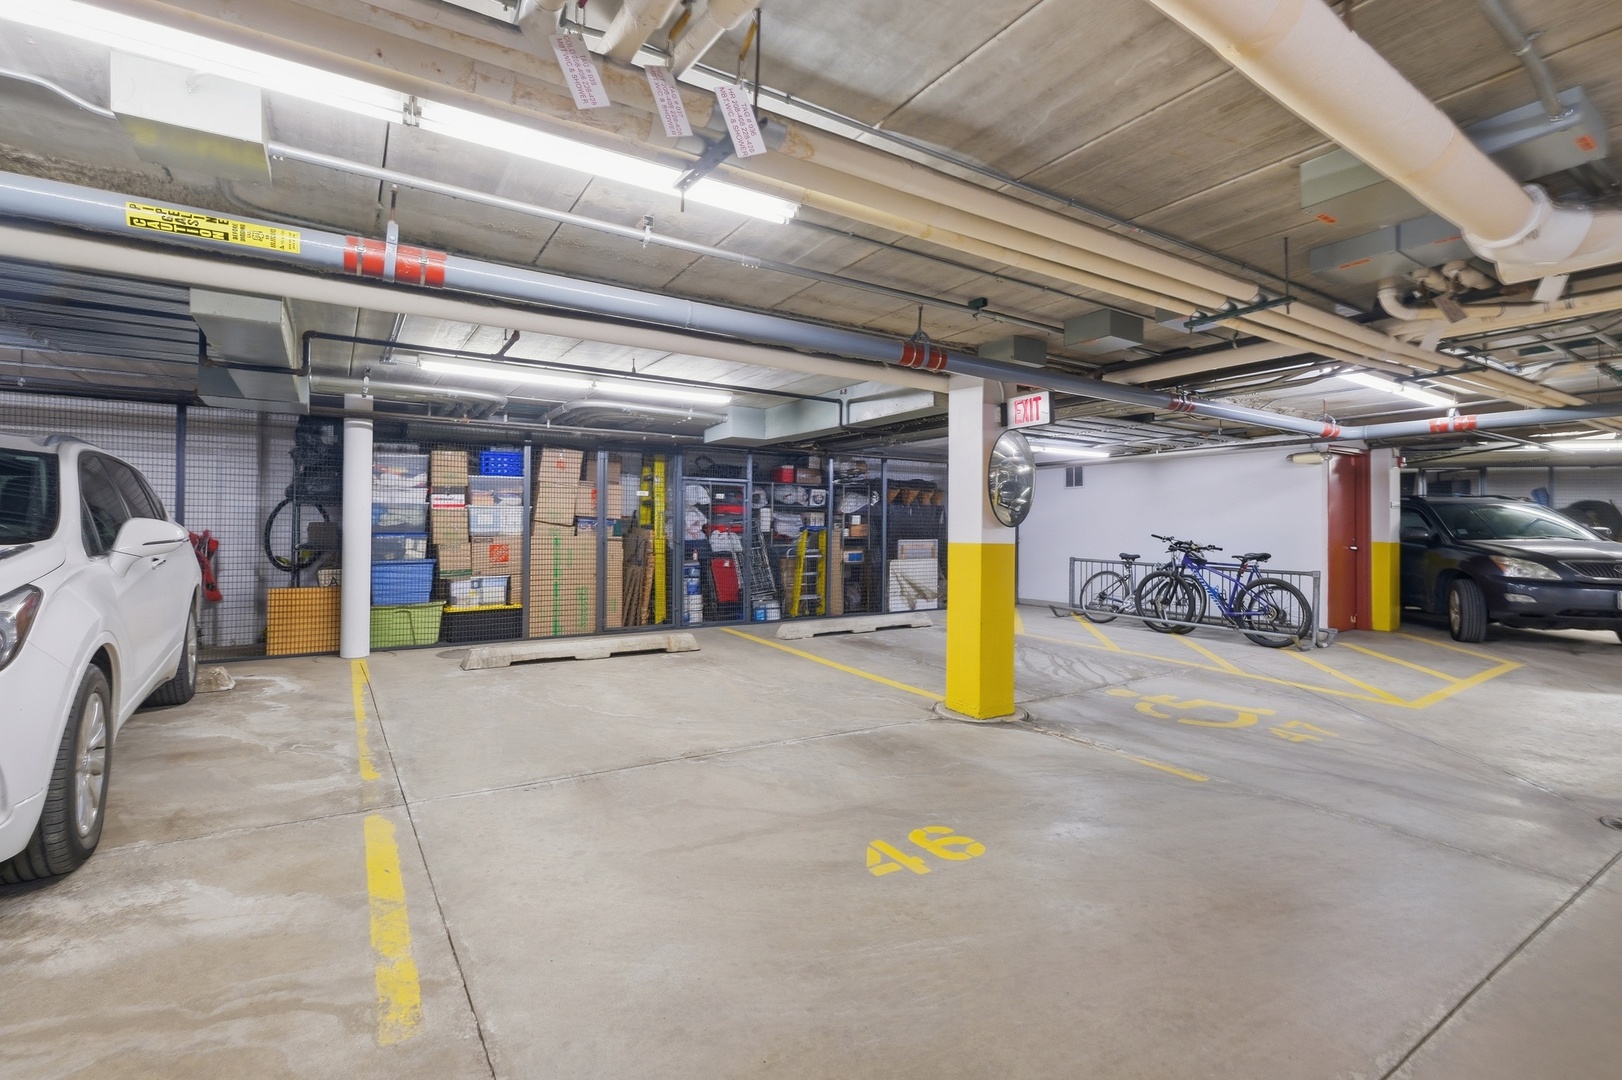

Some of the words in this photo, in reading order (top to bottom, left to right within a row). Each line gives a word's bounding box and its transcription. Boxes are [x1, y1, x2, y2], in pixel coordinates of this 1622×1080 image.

[563, 35, 576, 55] COLD
[580, 55, 589, 68] TAG
[572, 74, 589, 104] SHOWER
[728, 87, 737, 99] HR
[662, 104, 677, 135] SHOWER
[741, 103, 751, 118] TAG
[733, 125, 749, 157] SHOWER
[129, 203, 230, 225] PIPELINE
[162, 214, 199, 227] GAS
[131, 218, 226, 241] CAUTION
[1014, 396, 1042, 425] EXIT
[1268, 720, 1340, 742] 47
[866, 825, 986, 877] 46
